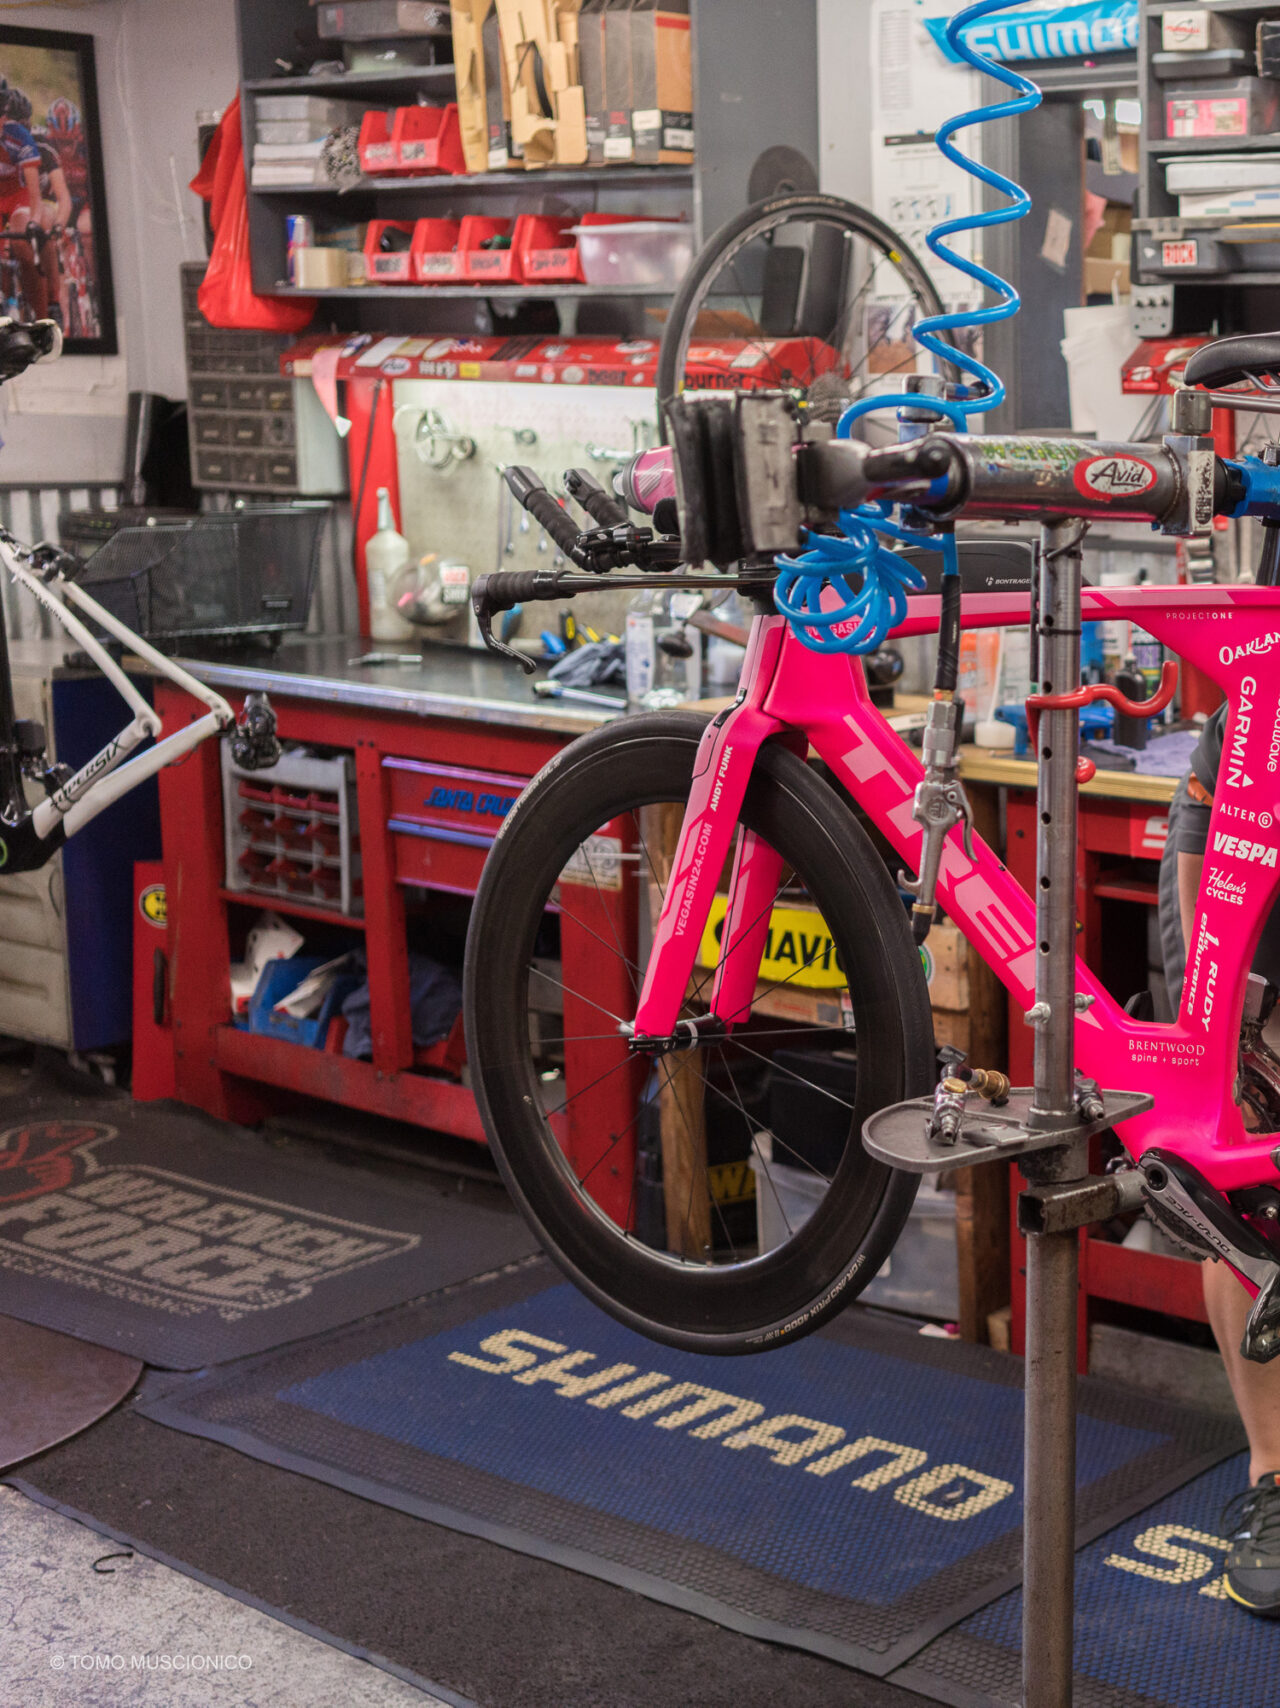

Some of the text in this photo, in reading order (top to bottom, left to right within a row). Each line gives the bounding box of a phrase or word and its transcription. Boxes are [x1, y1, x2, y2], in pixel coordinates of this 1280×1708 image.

[965, 17, 1139, 61] SHIMA
[1091, 460, 1143, 487] Avid
[995, 577, 1032, 585] BONTRAGE
[1225, 676, 1257, 788] GARMIN
[709, 745, 733, 811] ANDY FUNK
[424, 787, 474, 812] SANTA
[1213, 831, 1278, 868] VESPA
[675, 823, 713, 936] VEGASIN24.COM
[1206, 886, 1243, 905] CYCLES
[1208, 867, 1246, 895] Helen's
[765, 927, 848, 975] AVI
[1202, 961, 1218, 1032] RUDY
[1128, 1039, 1205, 1055] BRENTWOOD
[1131, 1053, 1158, 1064] spine
[1171, 1055, 1200, 1066] sport
[448, 1328, 1015, 1522] SHIMANO
